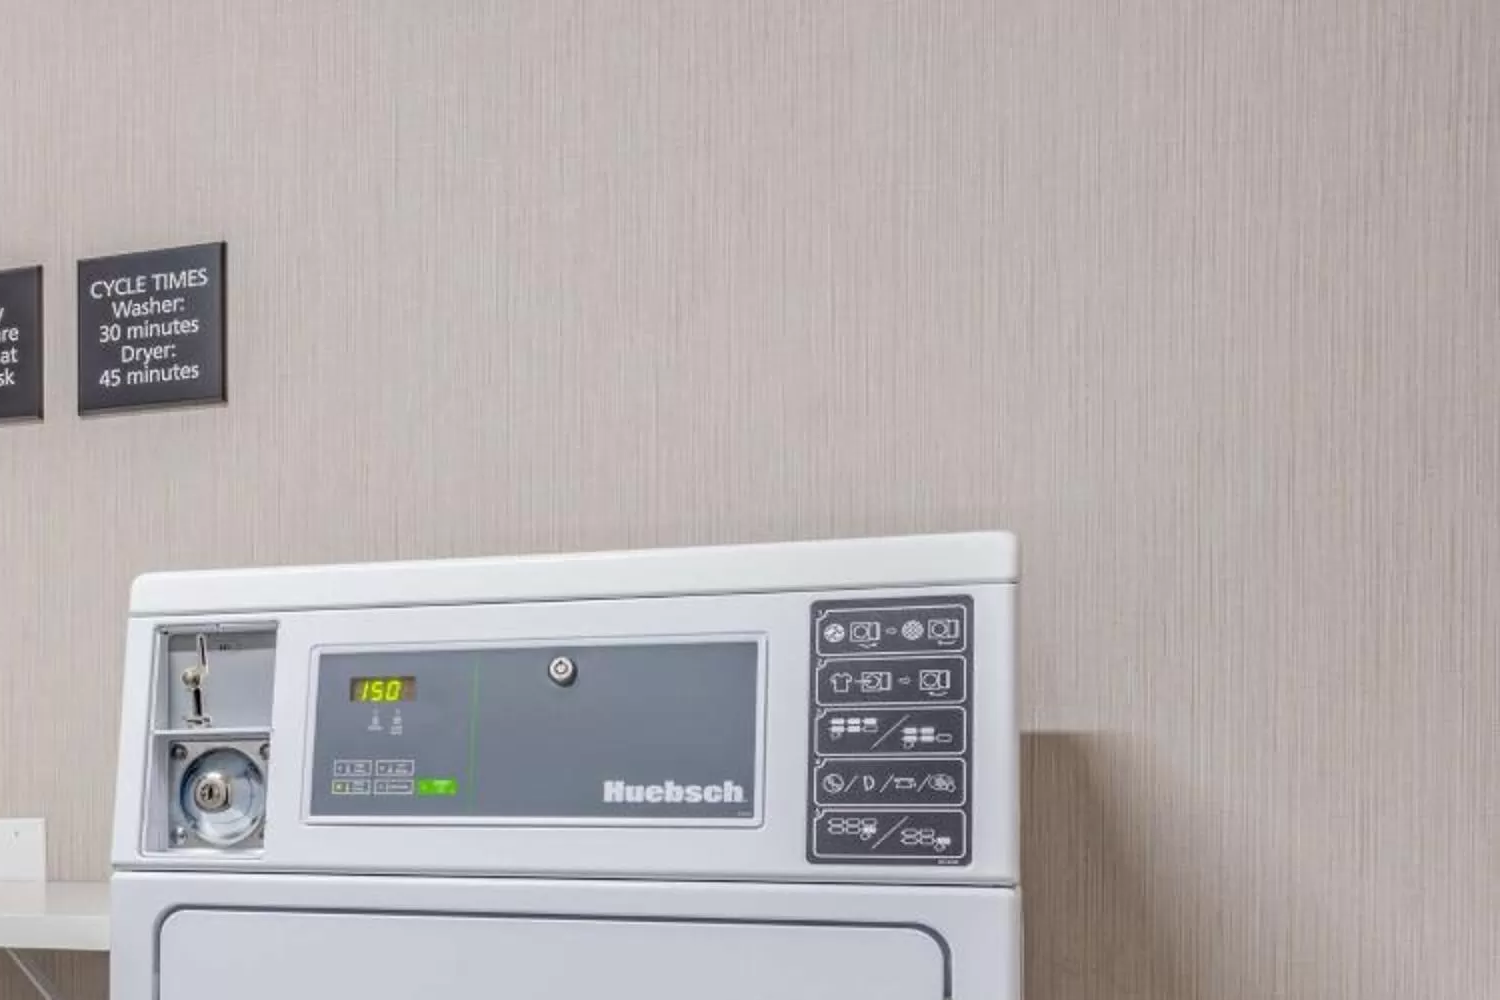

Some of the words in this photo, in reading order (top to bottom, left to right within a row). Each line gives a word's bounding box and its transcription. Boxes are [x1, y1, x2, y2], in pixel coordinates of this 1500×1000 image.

[90, 275, 147, 299] CYCLE
[151, 267, 209, 291] TIMES
[111, 296, 185, 319] Washer:
[99, 323, 121, 343] 30
[126, 319, 200, 339] minutes
[0, 346, 18, 365] at
[121, 344, 177, 366] Dryer:
[99, 368, 121, 387] 45
[126, 363, 200, 385] minutes
[603, 780, 744, 803] Huebsch
